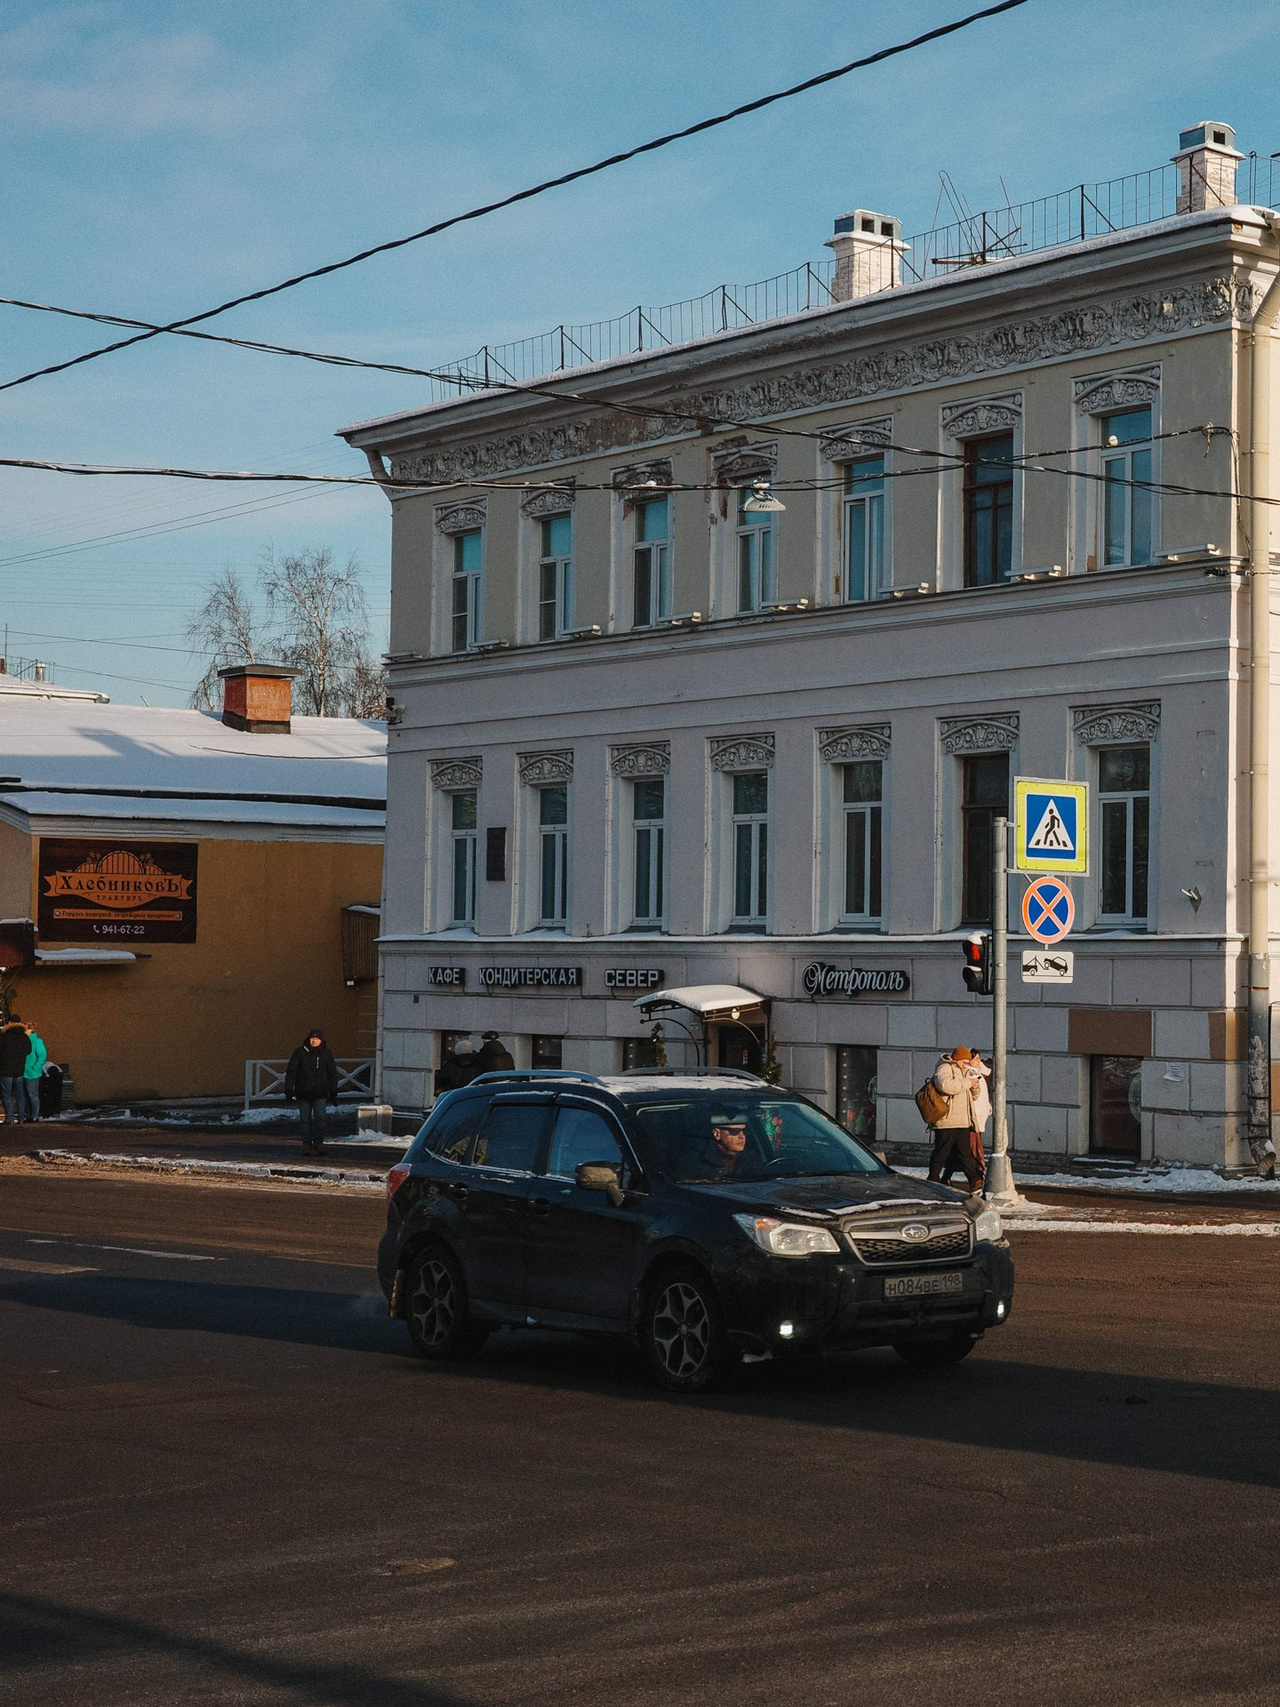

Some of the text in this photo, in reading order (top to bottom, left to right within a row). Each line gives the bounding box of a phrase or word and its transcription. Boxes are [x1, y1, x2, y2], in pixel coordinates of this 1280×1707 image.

[102, 924, 145, 934] 941-67-22
[428, 968, 659, 988] КАФЕ КОНДИТЕРСКАЯ СЕВЕР
[803, 962, 905, 995] Метрополь
